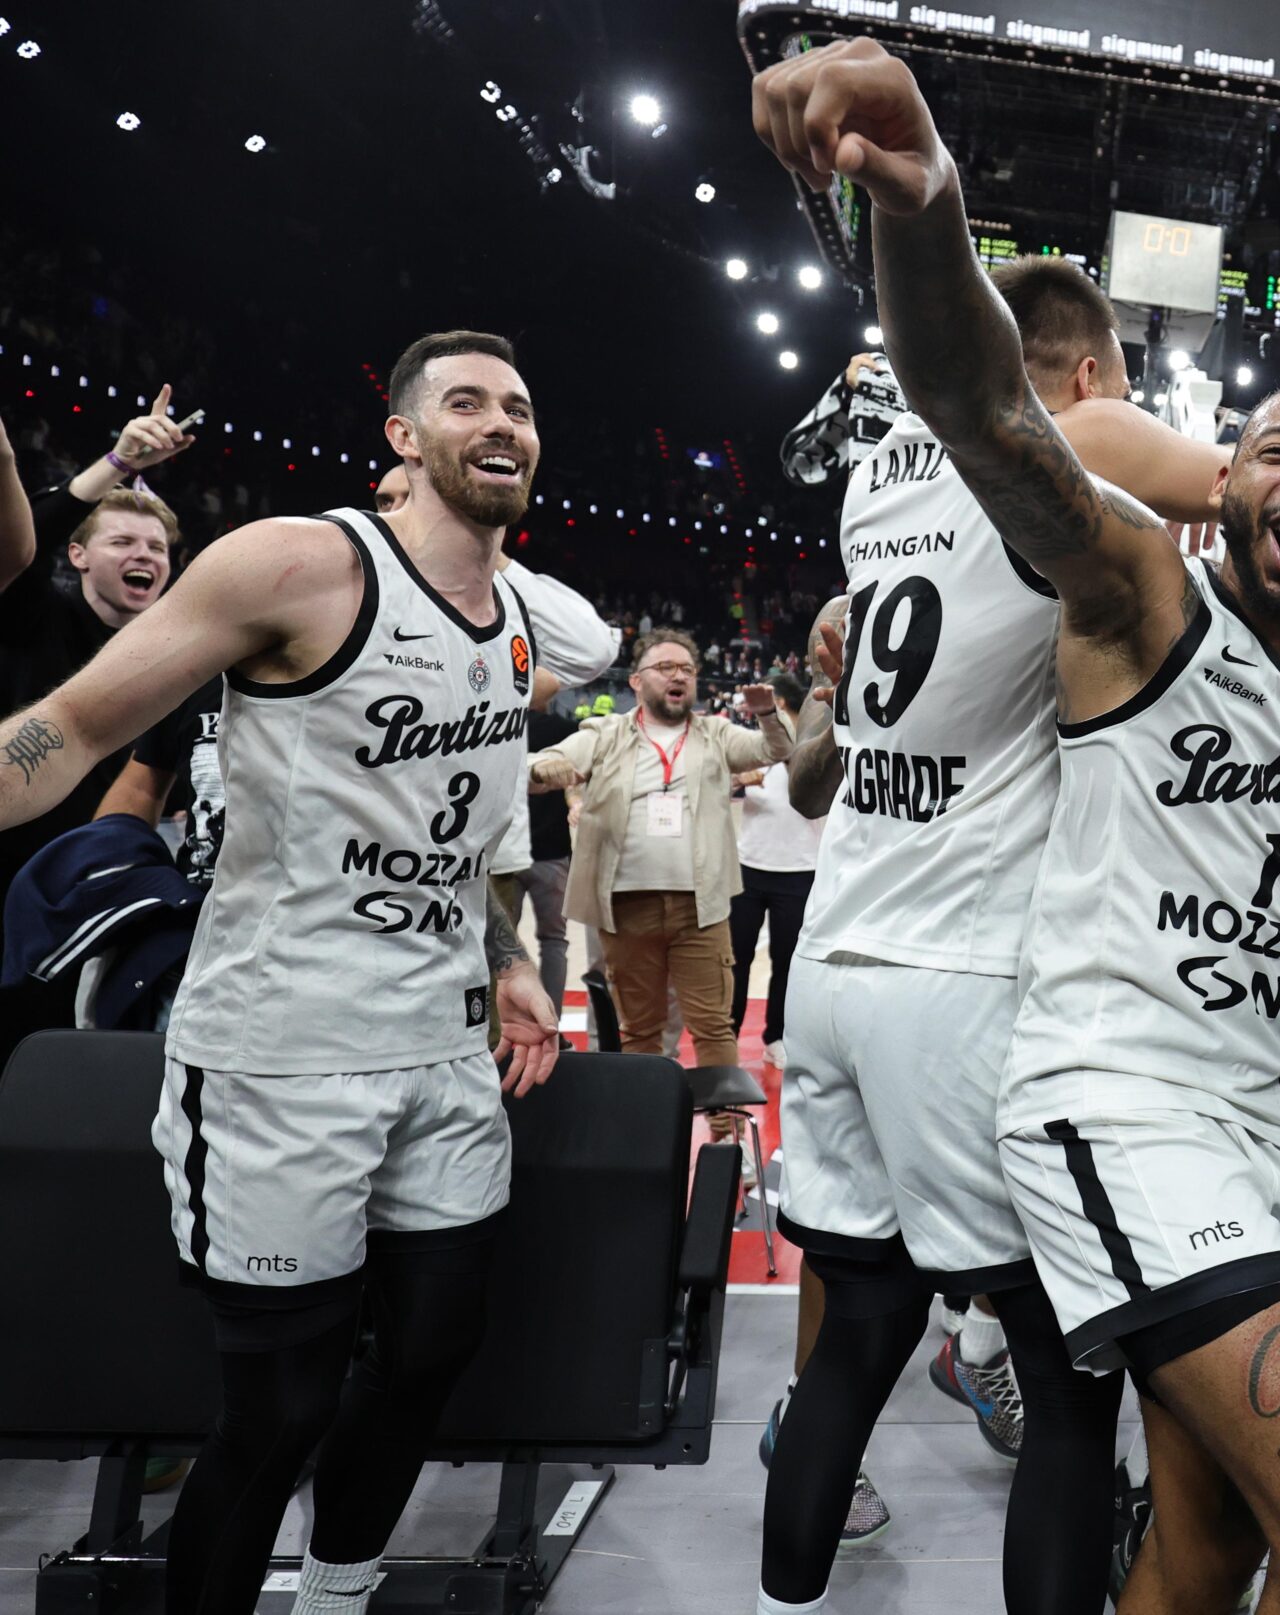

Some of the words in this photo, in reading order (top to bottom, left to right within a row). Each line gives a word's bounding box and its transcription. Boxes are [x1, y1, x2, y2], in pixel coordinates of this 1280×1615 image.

[909, 5, 995, 34] siegmund
[1007, 18, 1090, 49] siegmund
[1101, 33, 1183, 63] siegmund
[1194, 48, 1275, 78] siegmund
[395, 655, 445, 672] AikBank
[835, 575, 942, 728] 19
[1209, 673, 1268, 707] AikBank
[430, 771, 481, 845] 3
[1188, 1216, 1245, 1252] mts
[246, 1254, 298, 1272] mts
